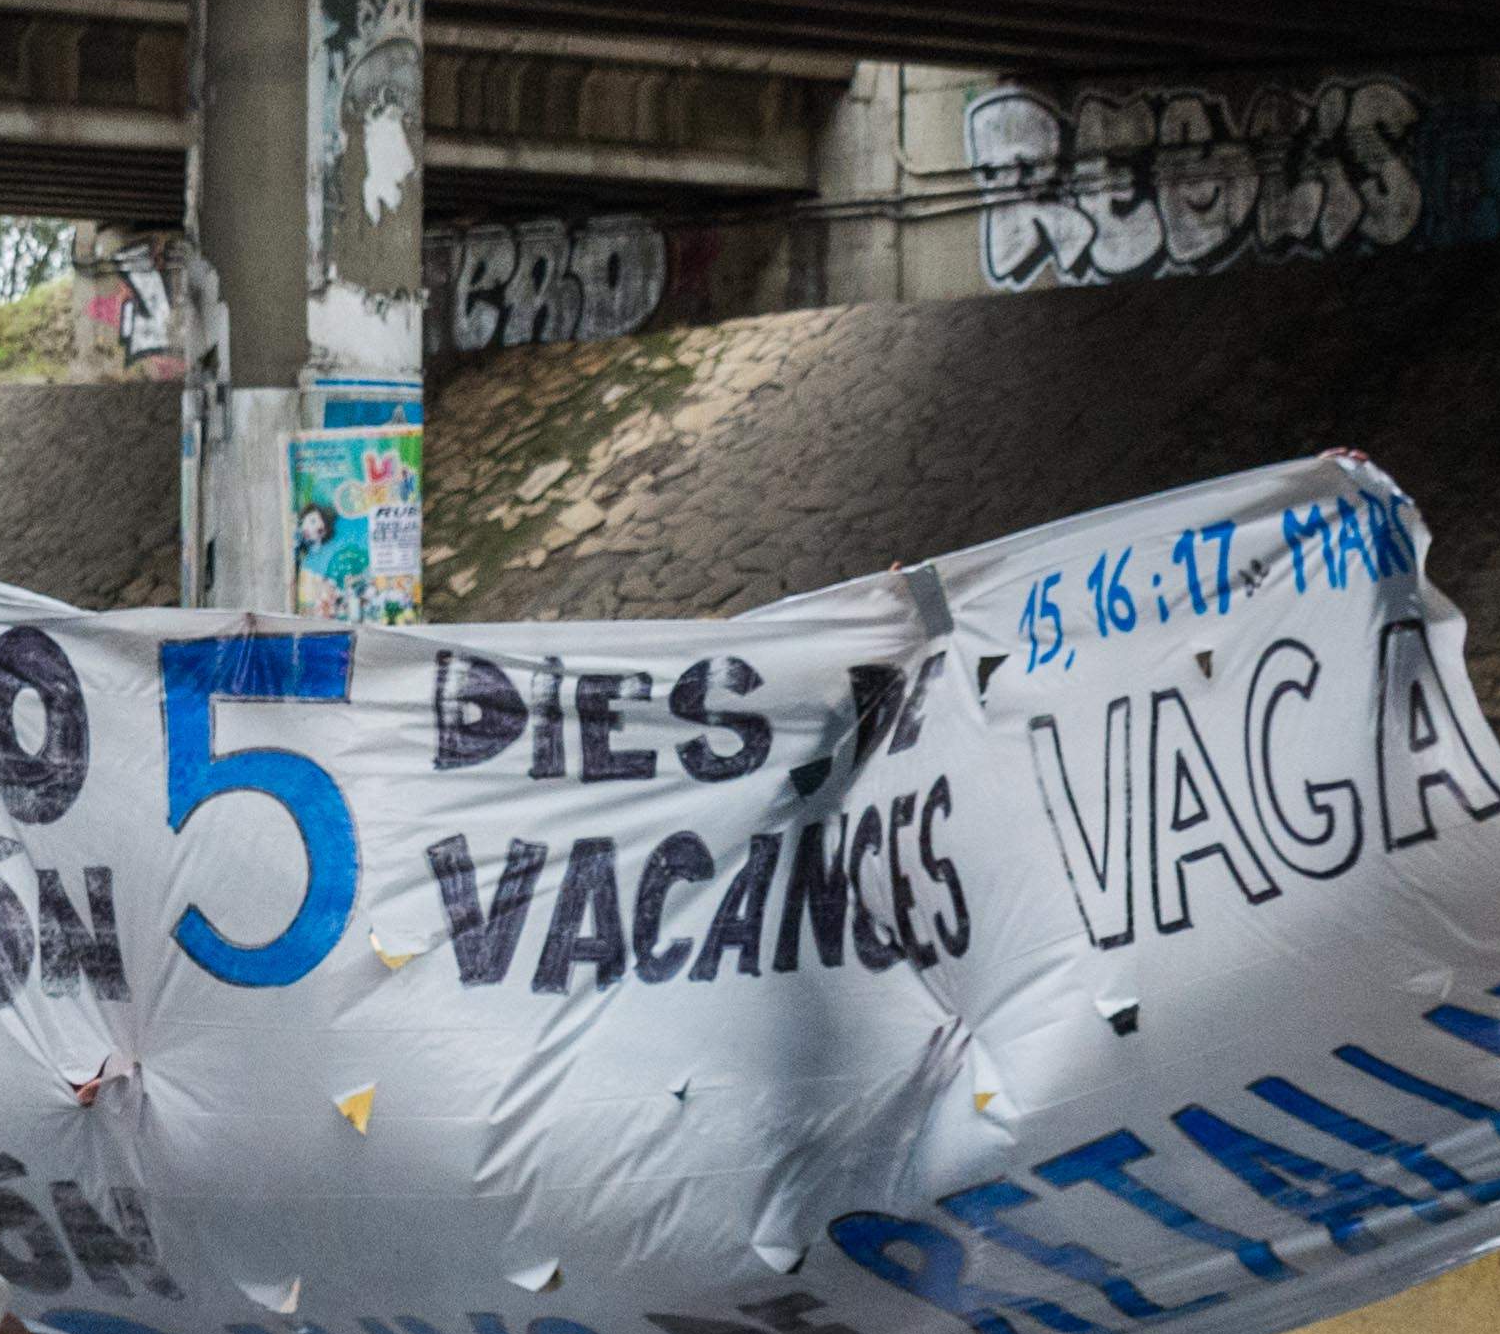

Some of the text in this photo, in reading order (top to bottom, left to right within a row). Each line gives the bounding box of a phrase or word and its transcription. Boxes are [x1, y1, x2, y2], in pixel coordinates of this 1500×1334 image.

[1087, 547, 1136, 637] 16
[1172, 519, 1237, 616] 17
[157, 629, 363, 989] 5
[433, 649, 774, 784] DIES
[848, 650, 948, 779] DE
[426, 774, 972, 997] VACANCES
